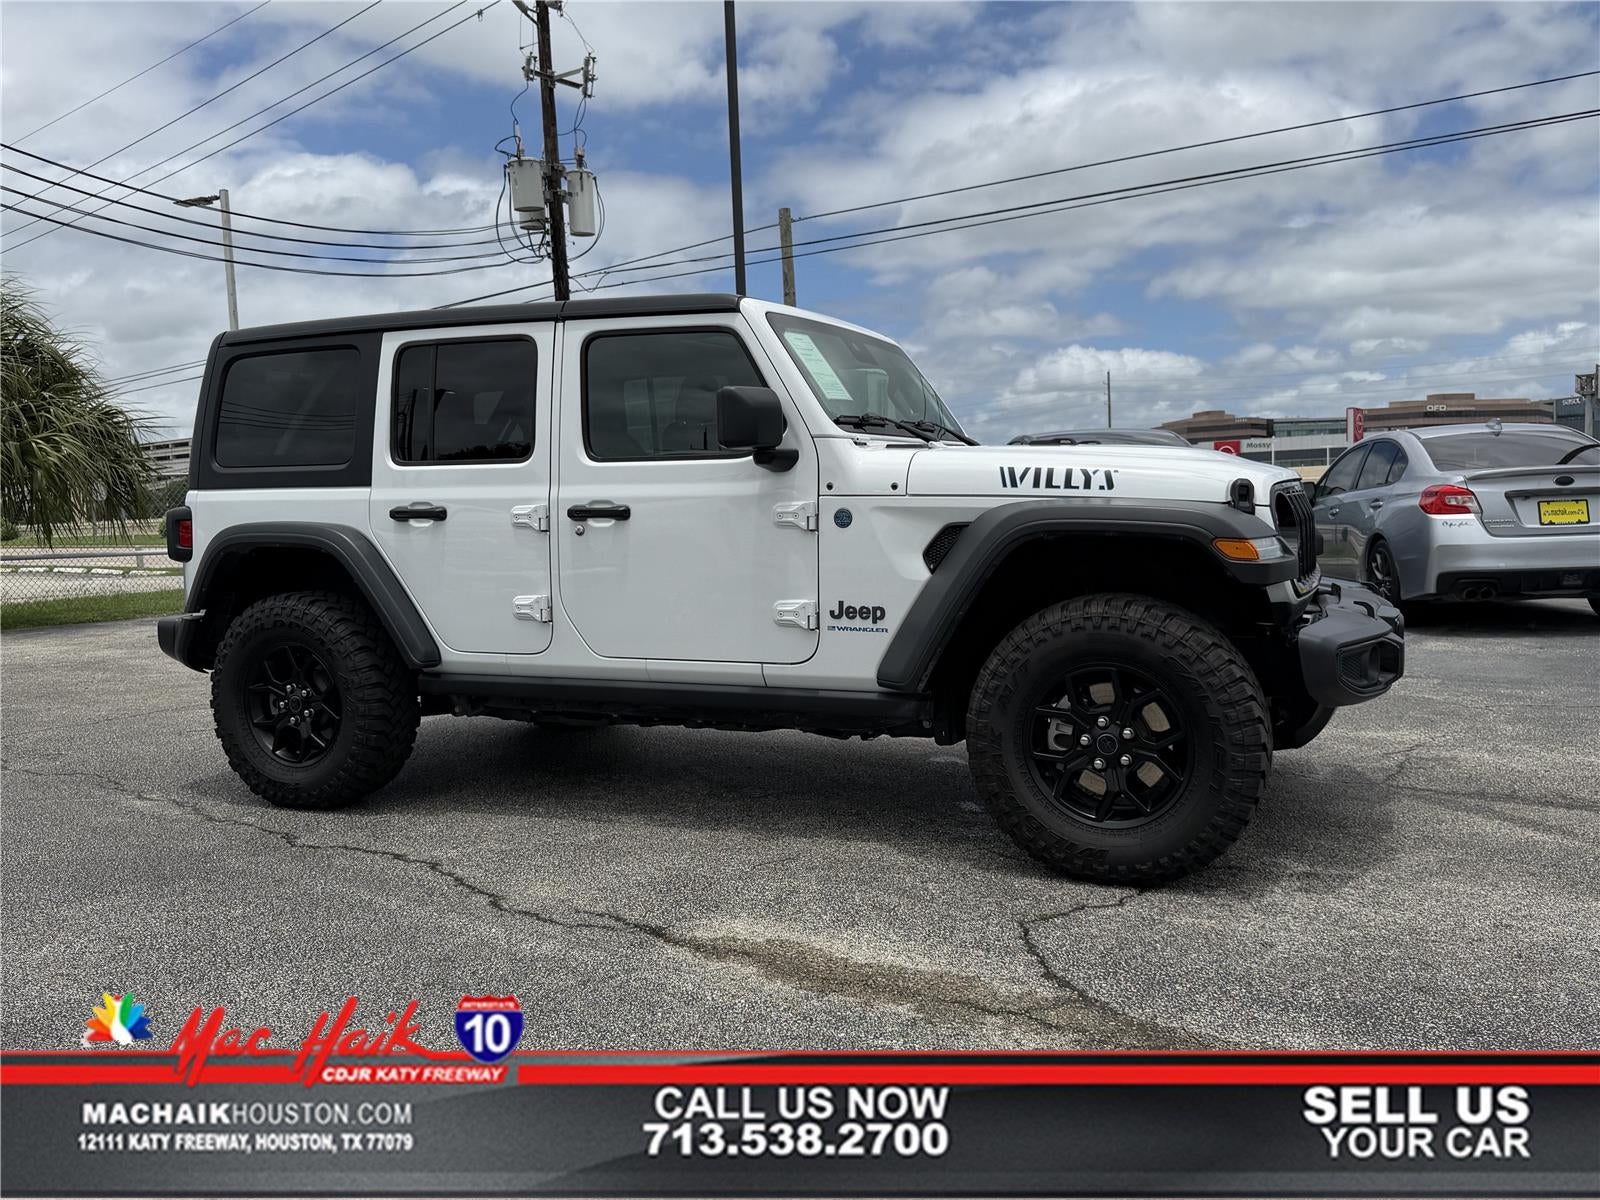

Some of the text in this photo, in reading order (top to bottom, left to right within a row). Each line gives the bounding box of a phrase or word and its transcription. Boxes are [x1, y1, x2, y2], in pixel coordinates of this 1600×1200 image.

[1246, 441, 1272, 450] Mossy
[999, 466, 1119, 490] WILLYS
[829, 600, 886, 624] Jeep
[836, 625, 889, 634] WRANGLER
